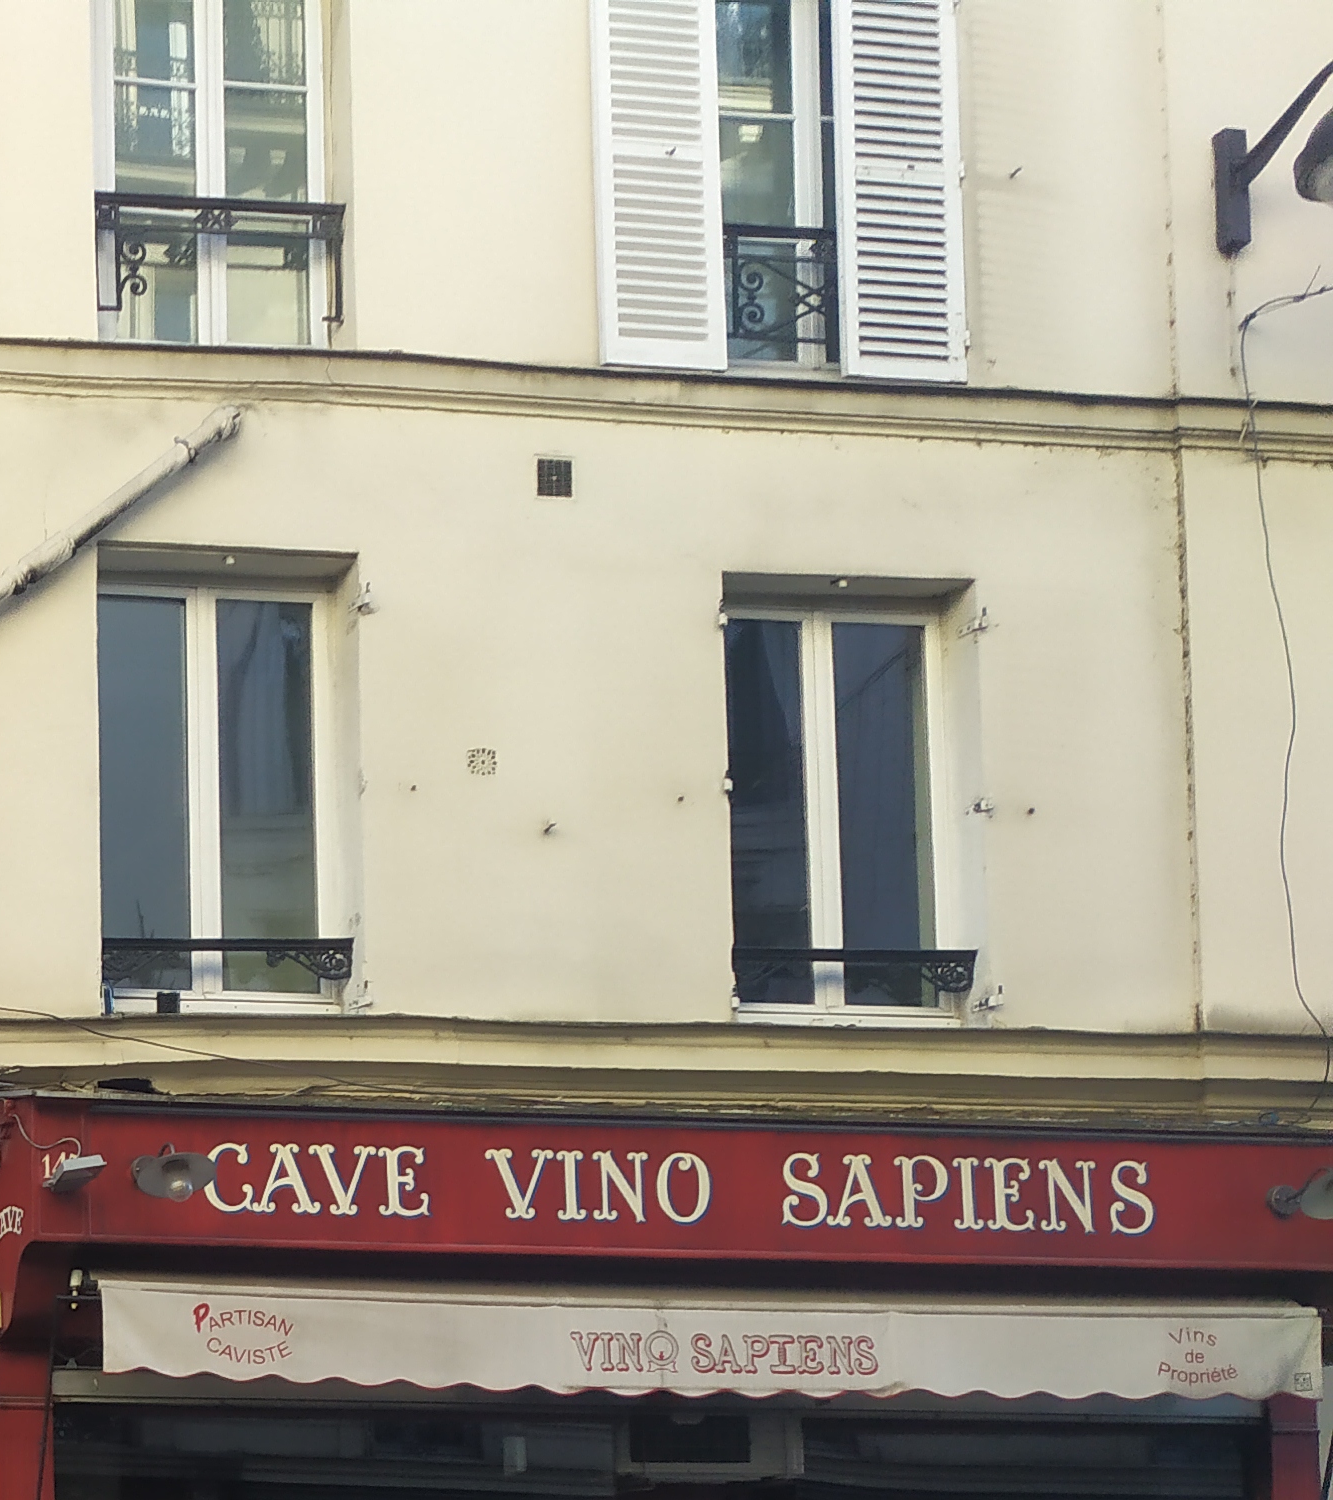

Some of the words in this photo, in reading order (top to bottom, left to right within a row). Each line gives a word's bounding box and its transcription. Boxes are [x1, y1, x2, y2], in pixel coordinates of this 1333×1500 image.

[203, 1142, 431, 1218] CAVE
[484, 1148, 712, 1226] VINO
[782, 1153, 1156, 1234] SAPIENS
[193, 1302, 294, 1336] PARTISAN
[206, 1337, 293, 1365] CAVISTE
[1168, 1327, 1217, 1347] Vins
[570, 1330, 679, 1373] VINO
[690, 1333, 878, 1375] SAPIENS
[1185, 1349, 1205, 1364] de
[1157, 1362, 1239, 1386] Propriété
